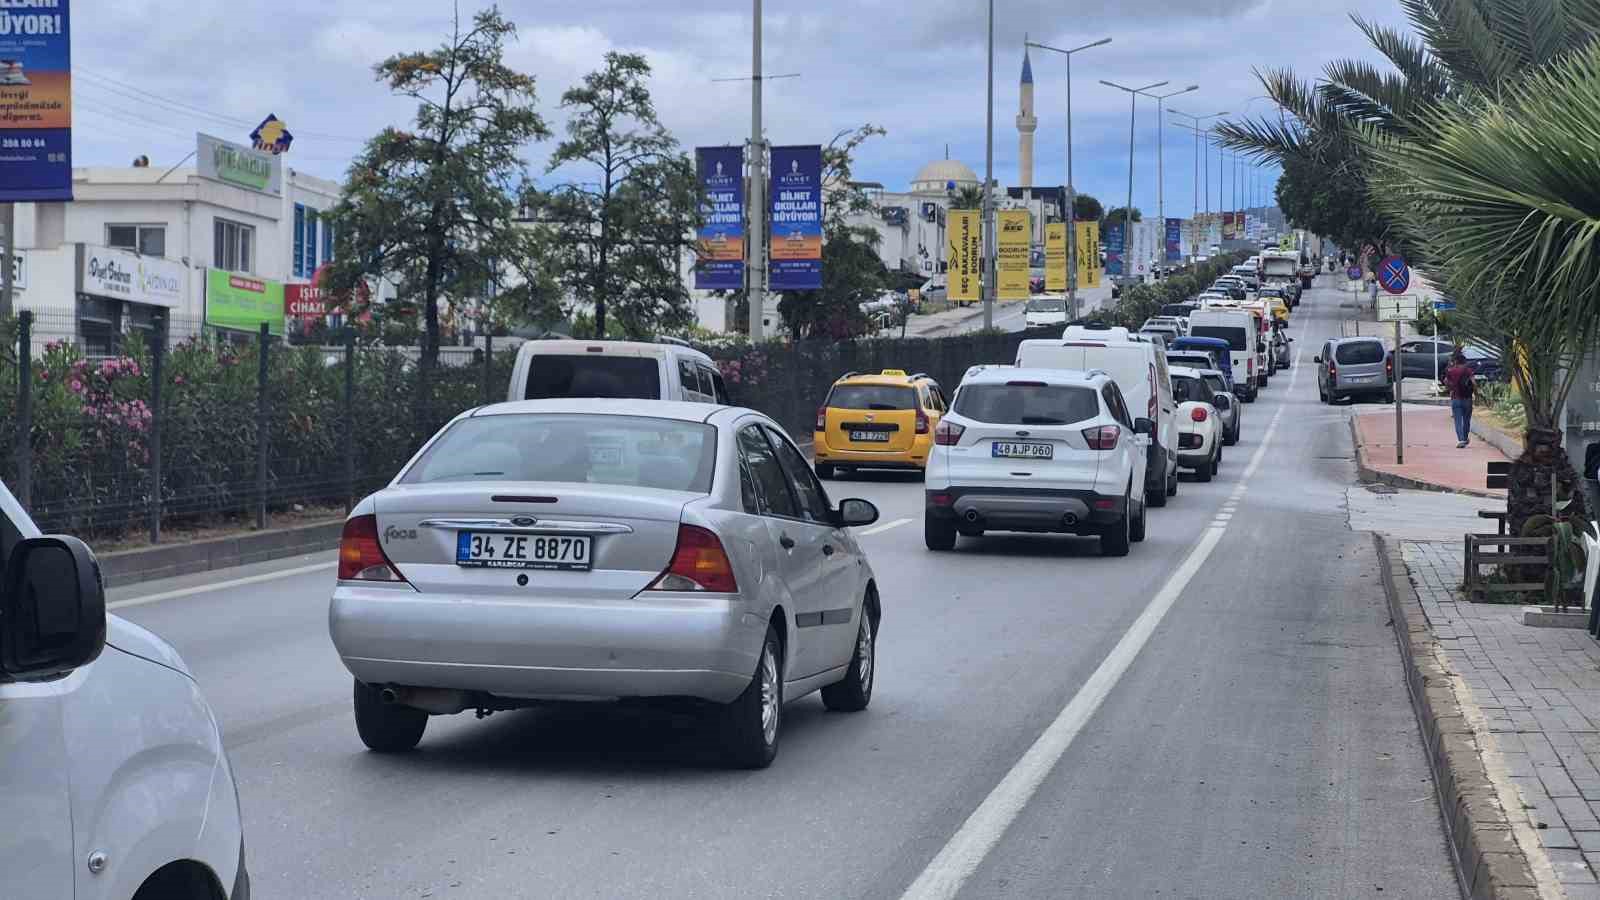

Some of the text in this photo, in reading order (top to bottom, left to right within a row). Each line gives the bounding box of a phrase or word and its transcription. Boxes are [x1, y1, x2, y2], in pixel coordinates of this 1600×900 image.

[780, 191, 811, 201] BİLNET
[774, 201, 817, 211] OKULLARI
[773, 211, 818, 222] BÜYÜYOR!
[1013, 444, 1031, 456] AJP
[1032, 446, 1052, 456] 060
[471, 535, 585, 561] 34 ZE 8870
